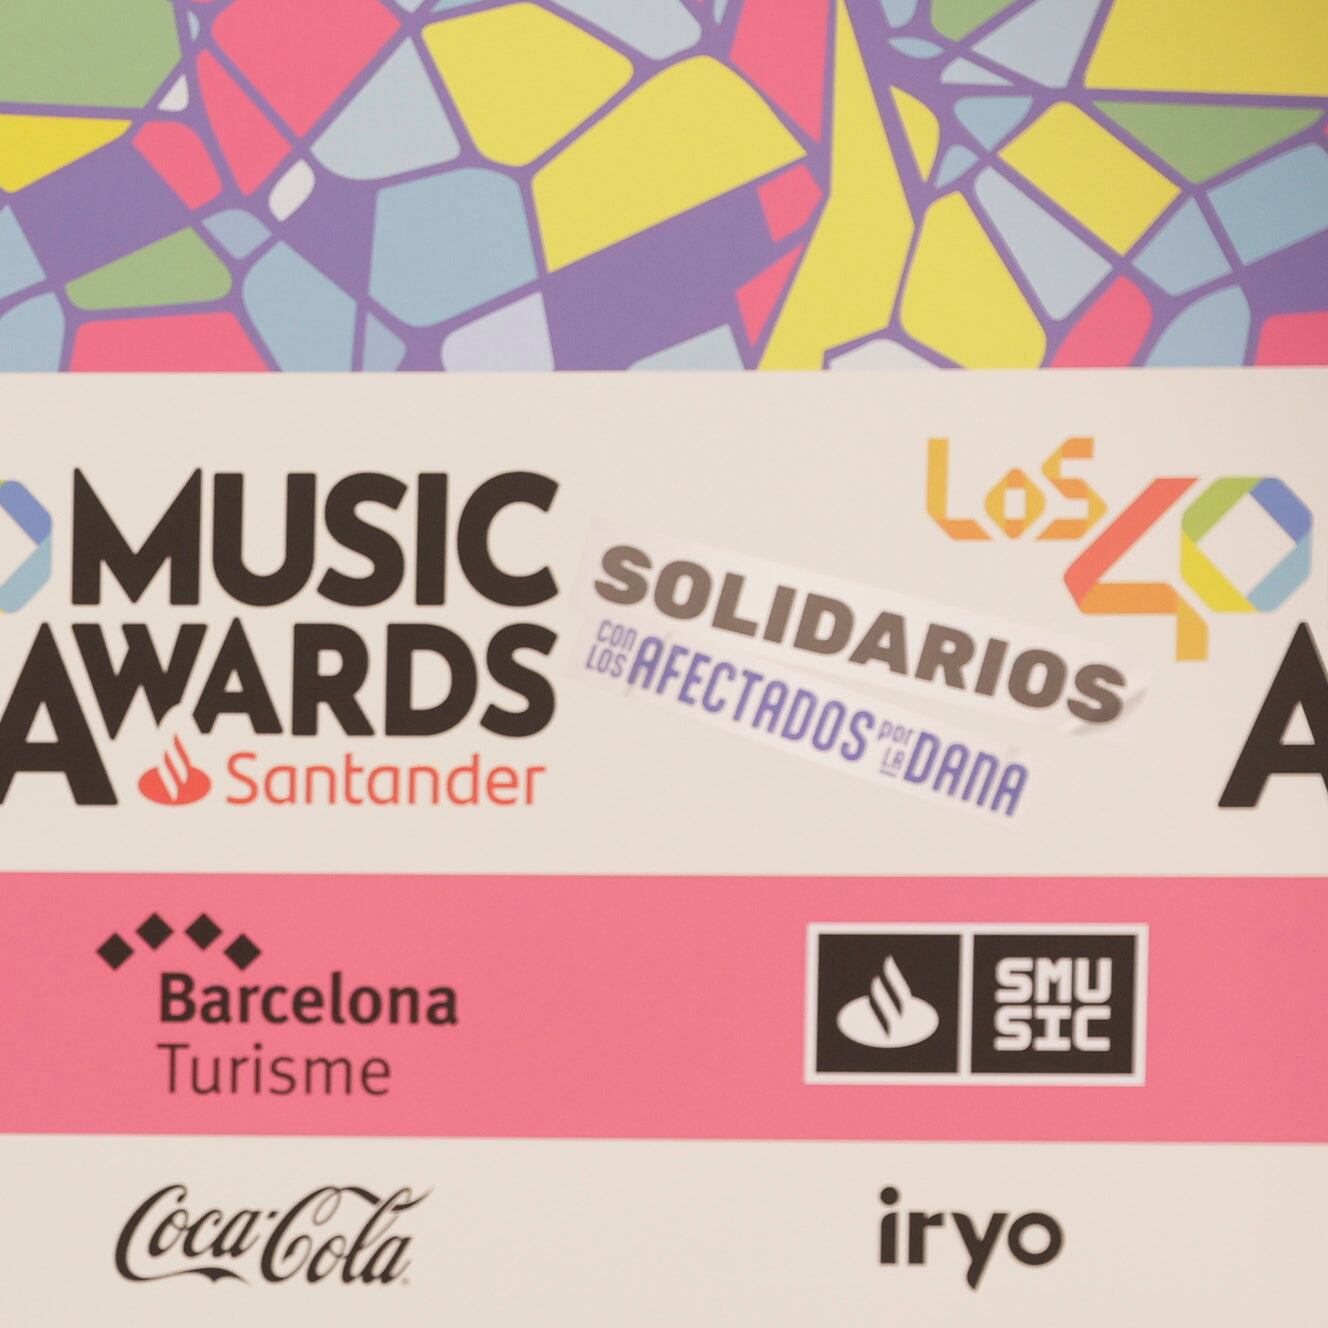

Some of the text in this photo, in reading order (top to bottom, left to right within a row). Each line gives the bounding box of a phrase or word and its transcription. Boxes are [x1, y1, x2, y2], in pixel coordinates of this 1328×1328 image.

[70, 467, 560, 608] MUSIC
[594, 544, 1127, 724] SOLIDARIOS
[584, 635, 875, 762] LOS AFECTADOS
[226, 751, 547, 807] Santander
[904, 730, 1030, 817] DANA
[157, 971, 459, 1027] Barcelona
[156, 1042, 392, 1097] Turisme
[878, 1186, 1063, 1291] iryo
